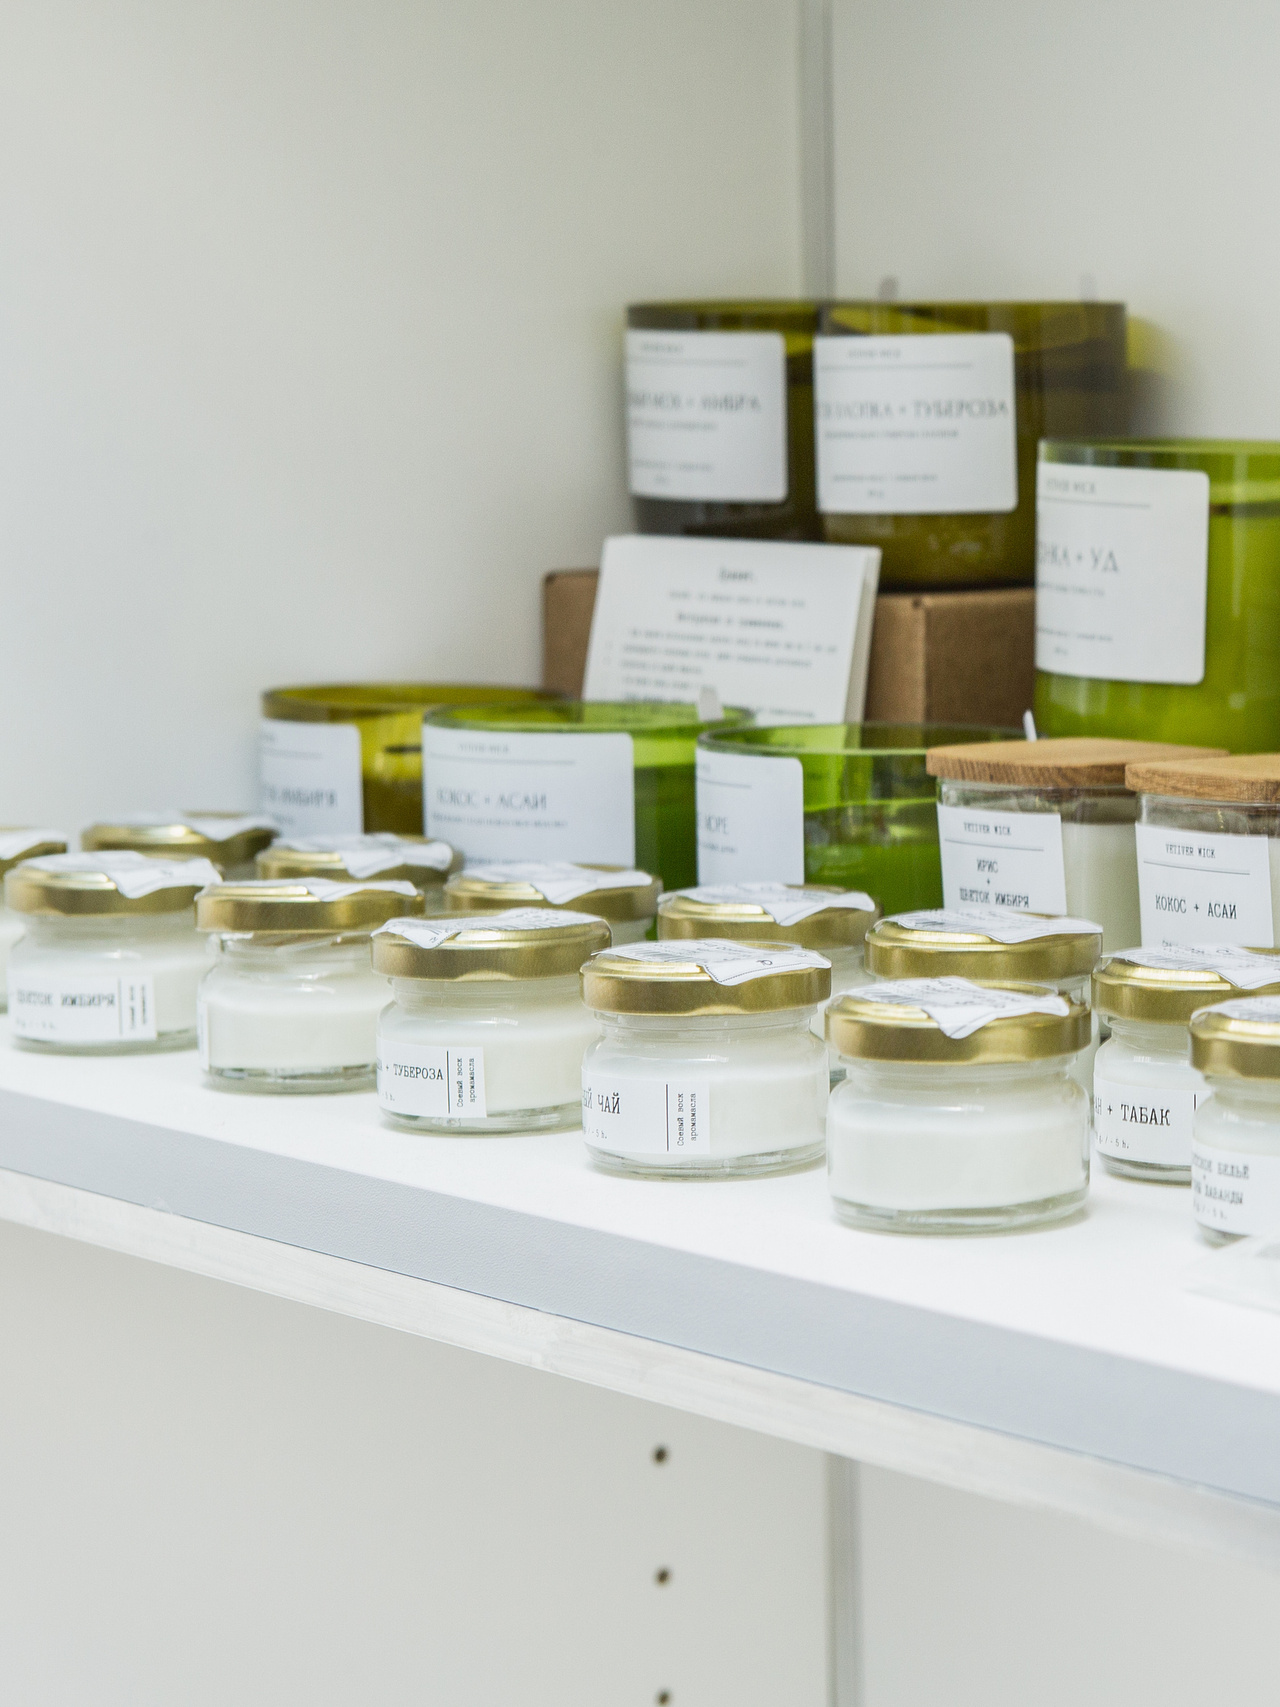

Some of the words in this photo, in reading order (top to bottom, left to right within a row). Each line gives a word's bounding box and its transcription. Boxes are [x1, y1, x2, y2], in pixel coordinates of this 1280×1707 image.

[1165, 843, 1194, 857] VETIVER
[1198, 847, 1216, 859] WICK
[976, 859, 998, 873] ИРИС
[995, 892, 1030, 908] ИМБИРЯ
[1155, 894, 1187, 914] КОКОС
[1207, 901, 1238, 920] АСАИ
[393, 1063, 444, 1081] ТУБЕРОЗА
[468, 1058, 477, 1103] аромамасла
[456, 1080, 464, 1108] Соевый
[597, 1091, 621, 1115] ЧАЙ
[690, 1093, 698, 1142] аромамасла
[1120, 1103, 1170, 1127] ТАБАК
[677, 1117, 685, 1147] Соевый
